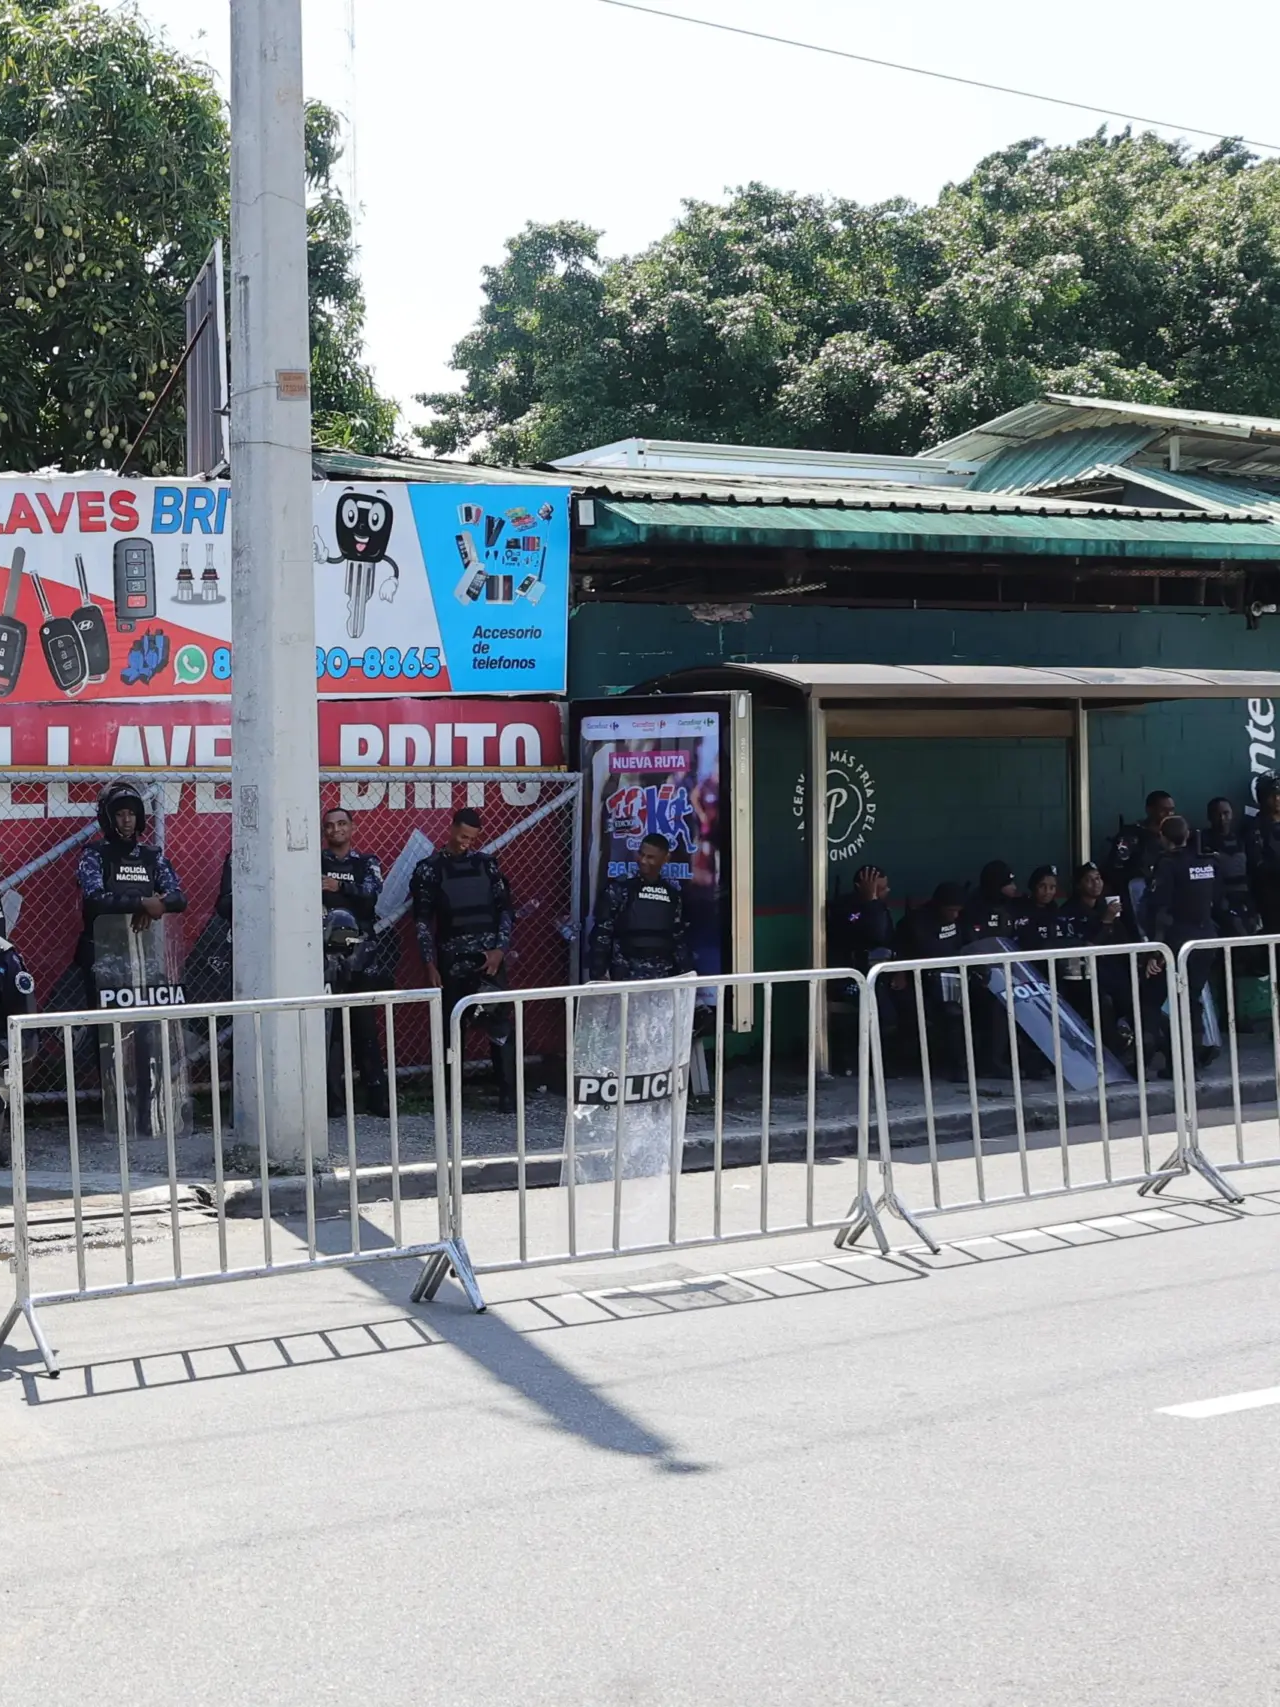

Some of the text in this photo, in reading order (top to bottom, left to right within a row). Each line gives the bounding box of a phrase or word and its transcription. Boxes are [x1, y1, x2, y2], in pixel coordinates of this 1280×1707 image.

[151, 486, 231, 534] BRI
[473, 626, 543, 640] Accesorio
[472, 641, 490, 655] de
[472, 656, 537, 670] telefonos
[340, 723, 542, 811] BRITO
[612, 755, 685, 769] NUEVA RUTA
[829, 749, 856, 768] MÁS
[855, 764, 875, 798] FRÍA
[862, 803, 876, 831] DEL
[829, 833, 865, 861] MUND
[116, 873, 150, 882] NACIONAL
[120, 865, 147, 875] POLICÍA
[327, 871, 355, 882] POLICÍA
[607, 862, 626, 878] 26
[661, 862, 694, 880] BRIL
[99, 986, 186, 1008] POLICIA
